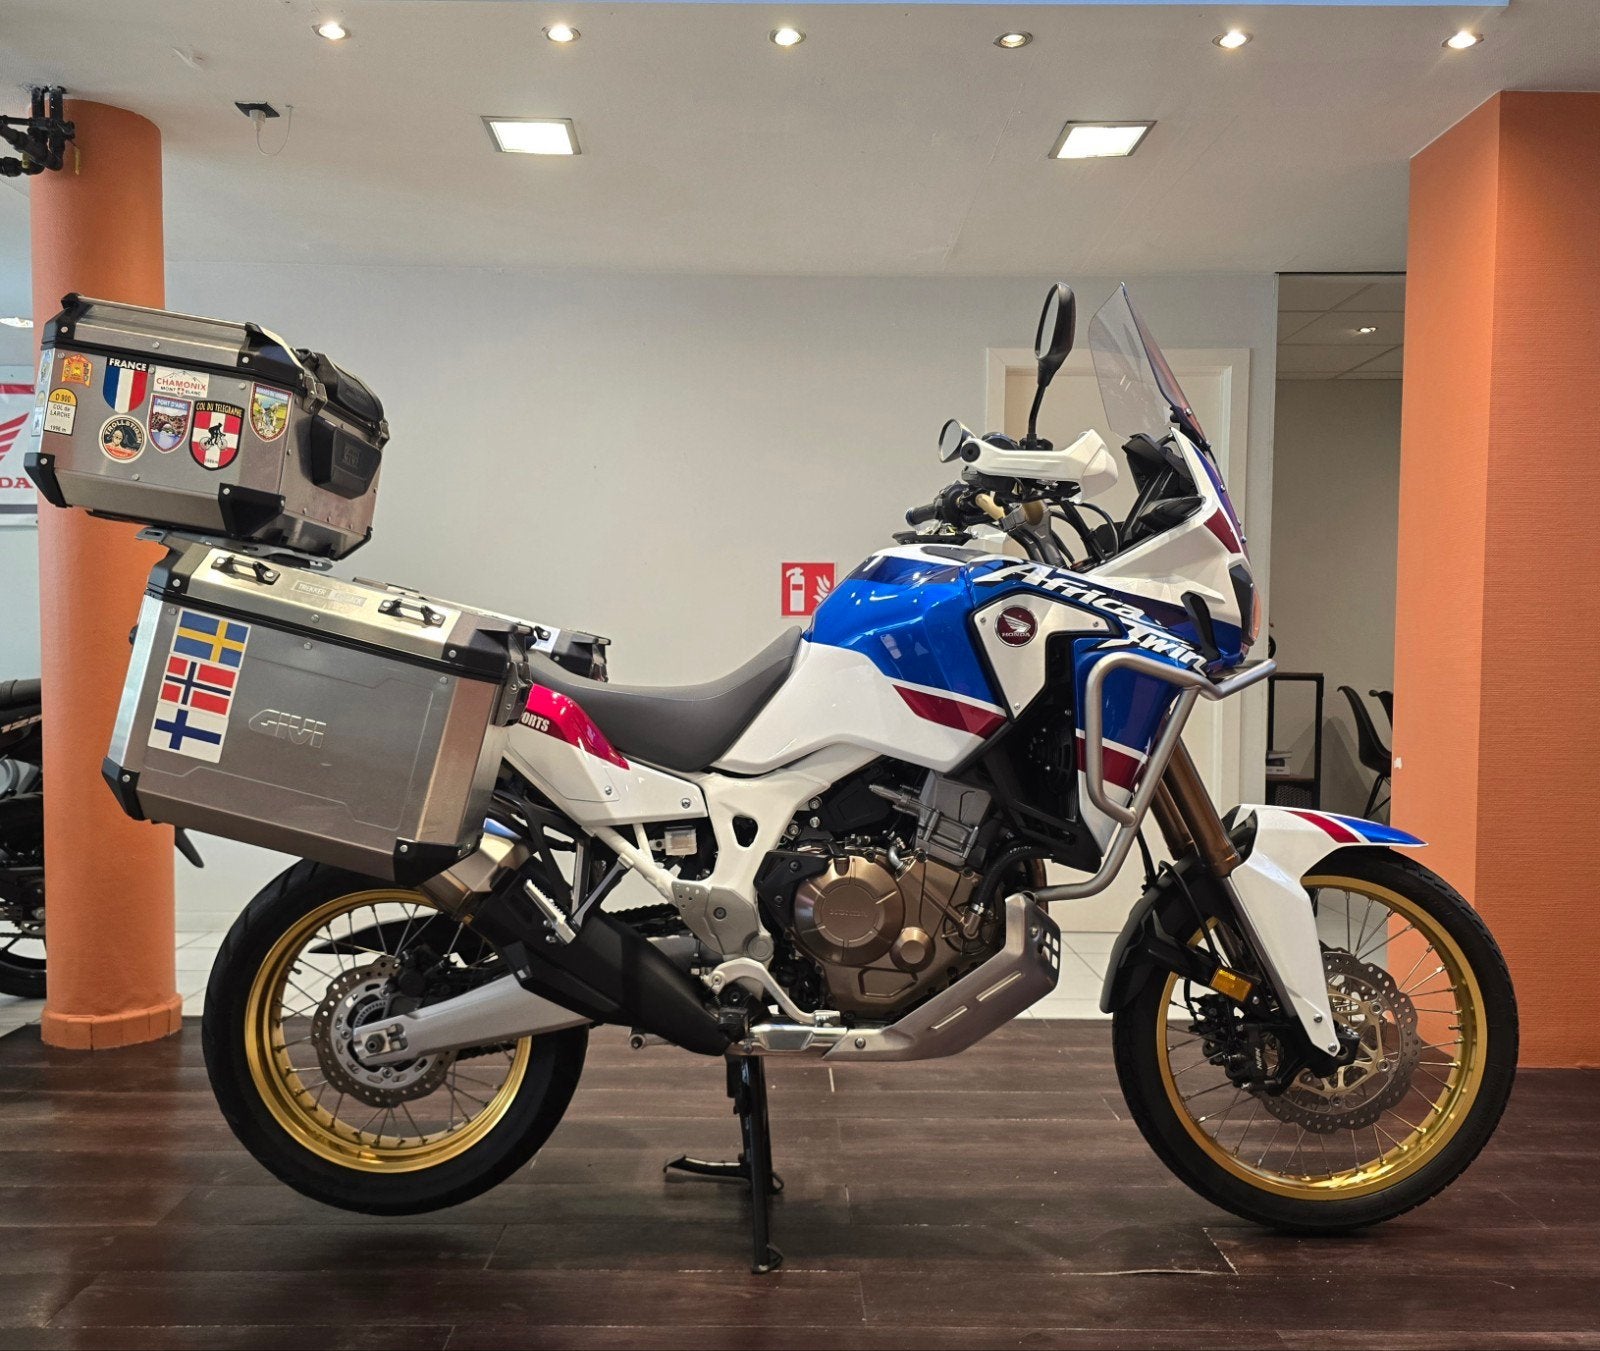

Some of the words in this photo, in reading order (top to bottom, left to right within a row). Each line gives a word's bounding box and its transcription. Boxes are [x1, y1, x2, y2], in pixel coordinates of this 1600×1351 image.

[109, 357, 147, 372] FRANCE
[156, 377, 207, 391] CHAMONIX
[55, 393, 60, 401] D
[61, 394, 71, 403] 900
[171, 401, 186, 409] D'ARC
[196, 402, 206, 411] COL
[207, 403, 214, 411] DU
[50, 410, 71, 419] LARCHE
[298, 583, 327, 596] TREKKER
[972, 562, 1145, 619] Africa
[1098, 616, 1207, 677] Twin
[248, 708, 327, 749] GIVI
